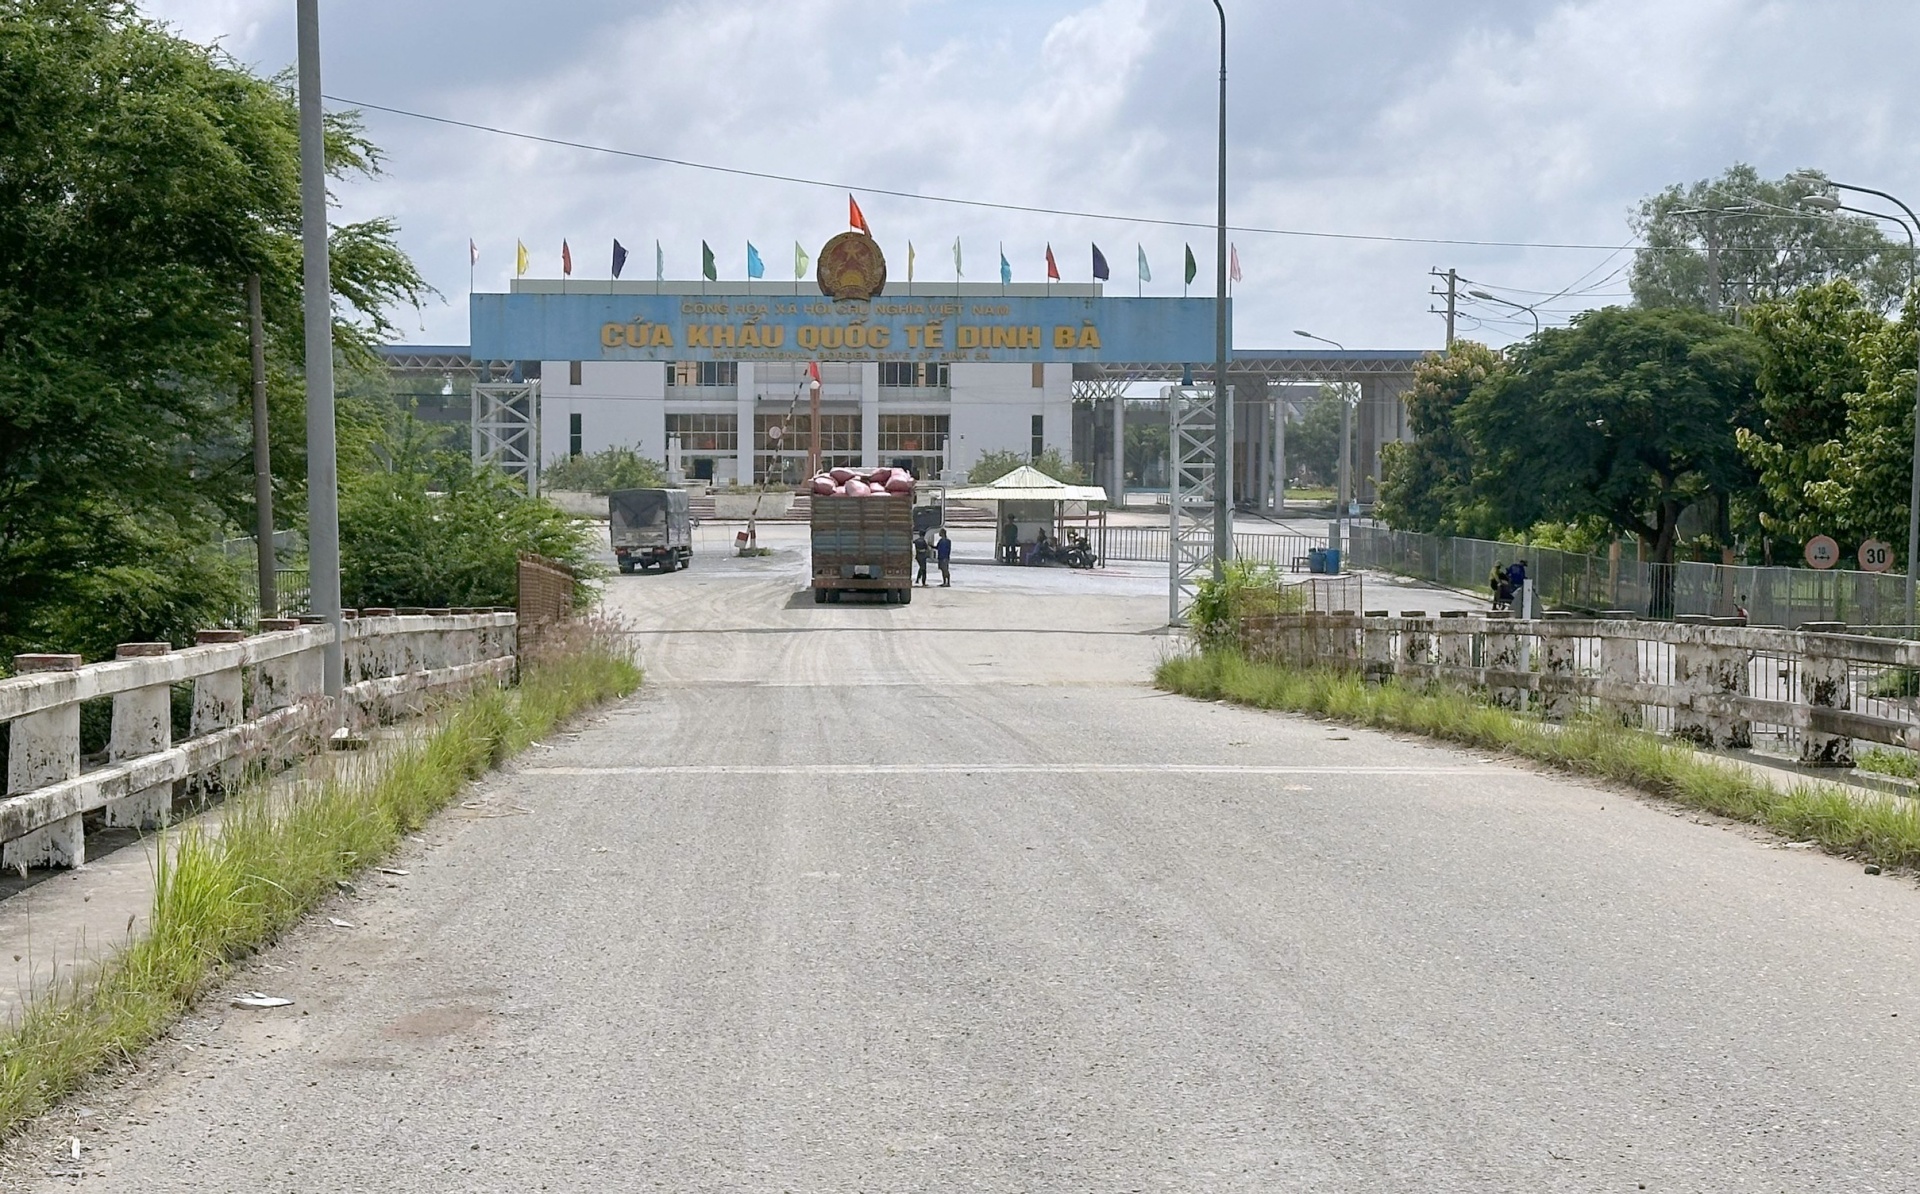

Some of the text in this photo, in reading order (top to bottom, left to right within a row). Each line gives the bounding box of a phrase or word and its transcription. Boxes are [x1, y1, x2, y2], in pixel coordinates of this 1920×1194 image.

[972, 304, 1010, 315] NAM
[601, 315, 674, 348] CỬA
[797, 317, 890, 350] QUỐC
[904, 317, 946, 348] TẾ
[958, 326, 1041, 349] DINH
[1054, 319, 1101, 349] BÀ
[818, 351, 871, 360] BORDER
[1866, 548, 1886, 564] 30
